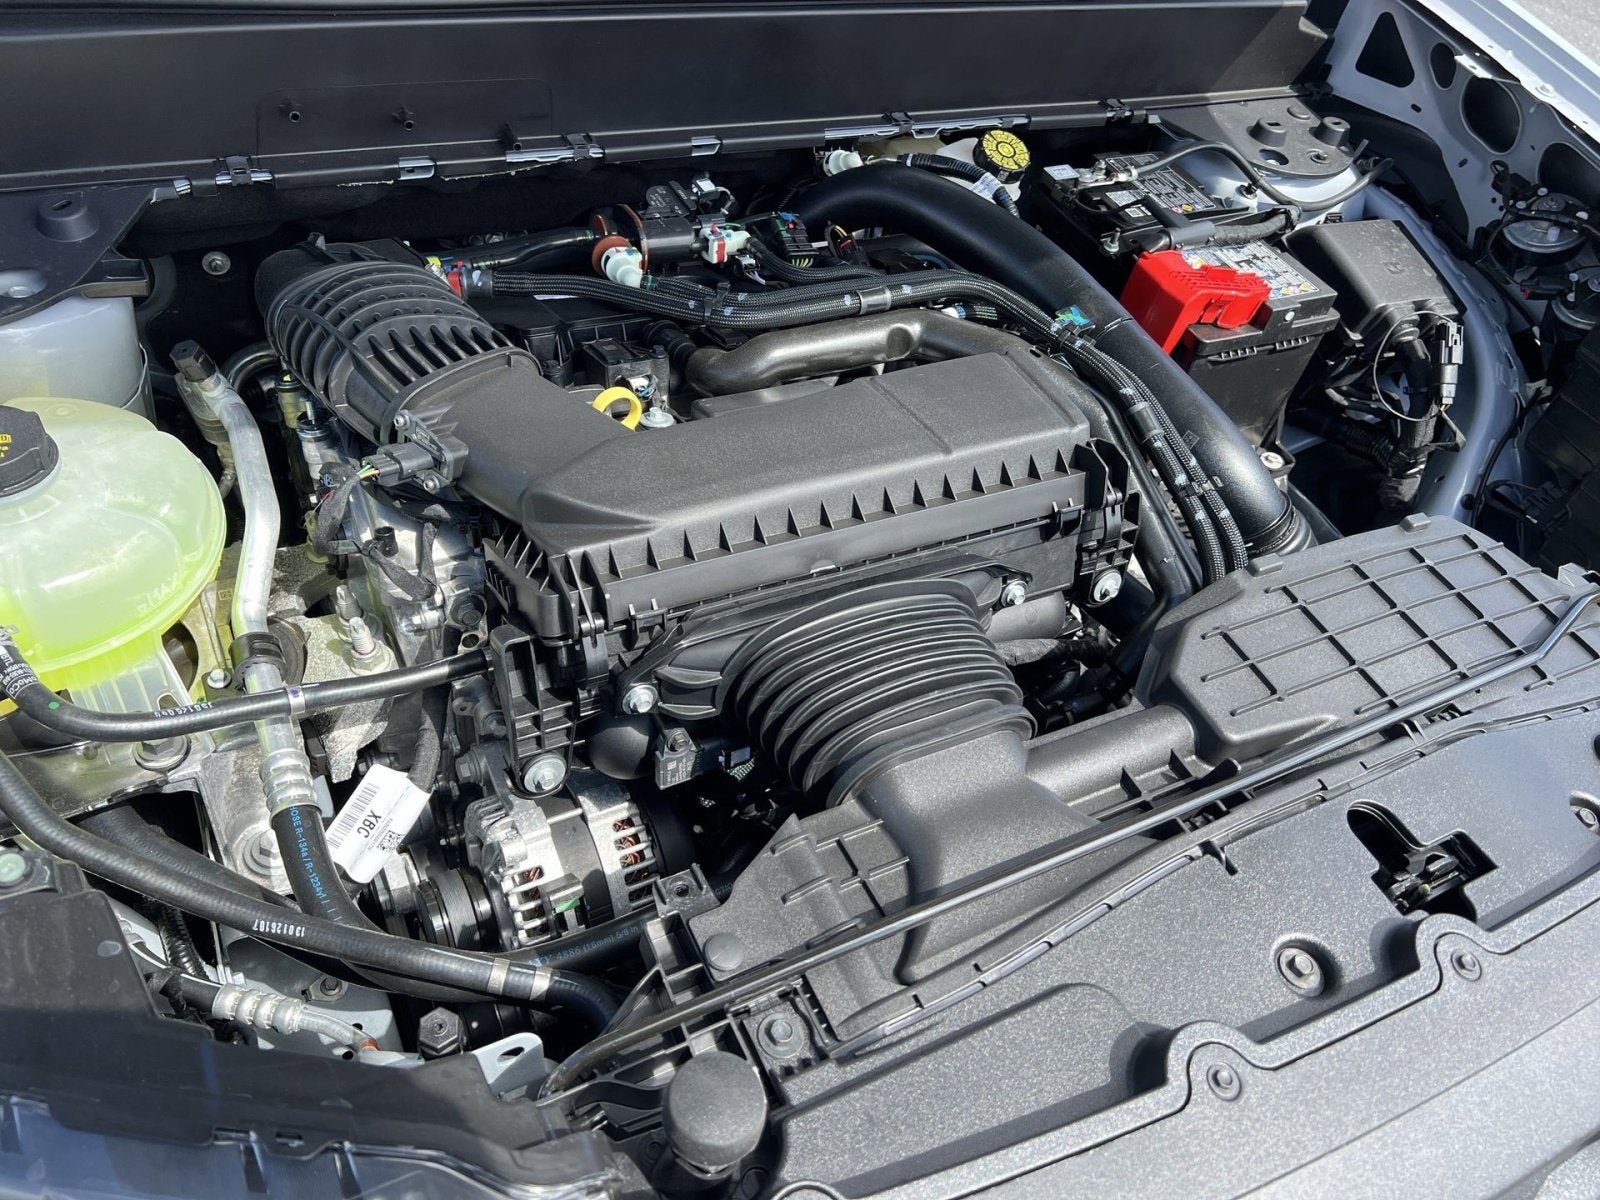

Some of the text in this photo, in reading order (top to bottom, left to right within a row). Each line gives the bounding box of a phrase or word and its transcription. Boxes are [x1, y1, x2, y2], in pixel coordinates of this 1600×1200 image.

[9, 676, 38, 694] oMoCo
[357, 810, 382, 838] XBC
[295, 827, 308, 858] R-134a
[252, 919, 306, 937] 130126107
